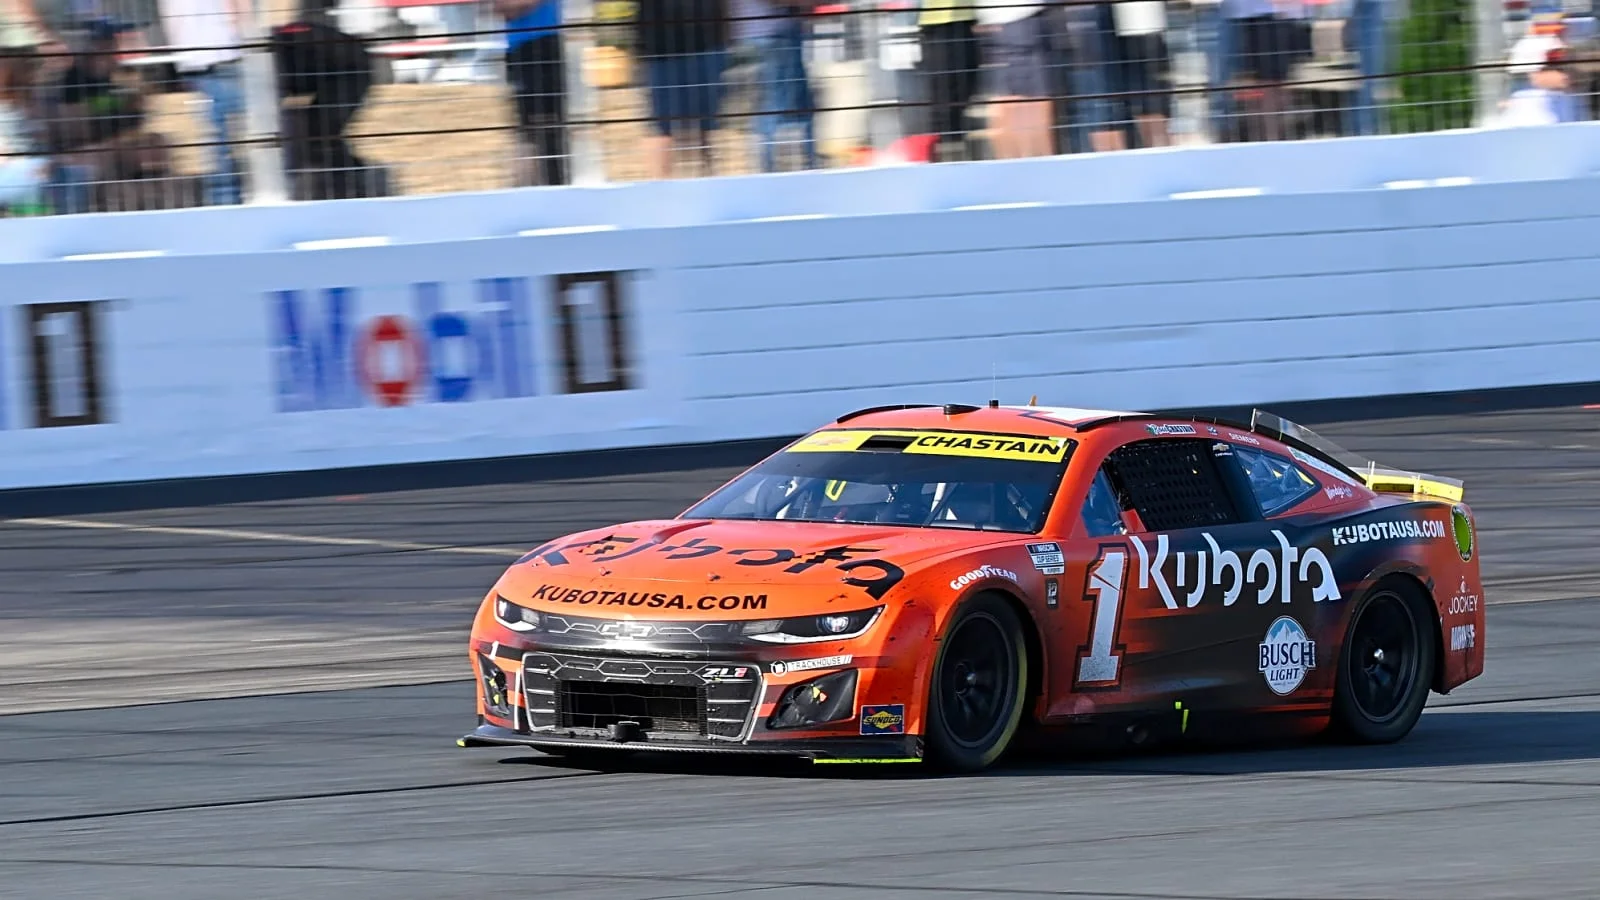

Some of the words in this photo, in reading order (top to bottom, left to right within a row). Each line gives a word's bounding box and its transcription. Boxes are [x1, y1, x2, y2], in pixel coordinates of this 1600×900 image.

[265, 276, 536, 412] Mobil
[917, 435, 1060, 455] CHASTAIN
[1332, 520, 1445, 546] KUBOTAUSA.COM
[949, 564, 1018, 591] GOODYEAR
[1129, 530, 1341, 609] Kubota
[532, 584, 768, 610] KUBOTAUSA.COM
[1448, 595, 1478, 615] JOCKEY
[1080, 552, 1124, 682] 1
[791, 656, 841, 670] TRACKHOUSE
[1260, 642, 1314, 669] BUSCH
[1270, 667, 1300, 681] LIGHT
[863, 714, 901, 726] SUNOCO
